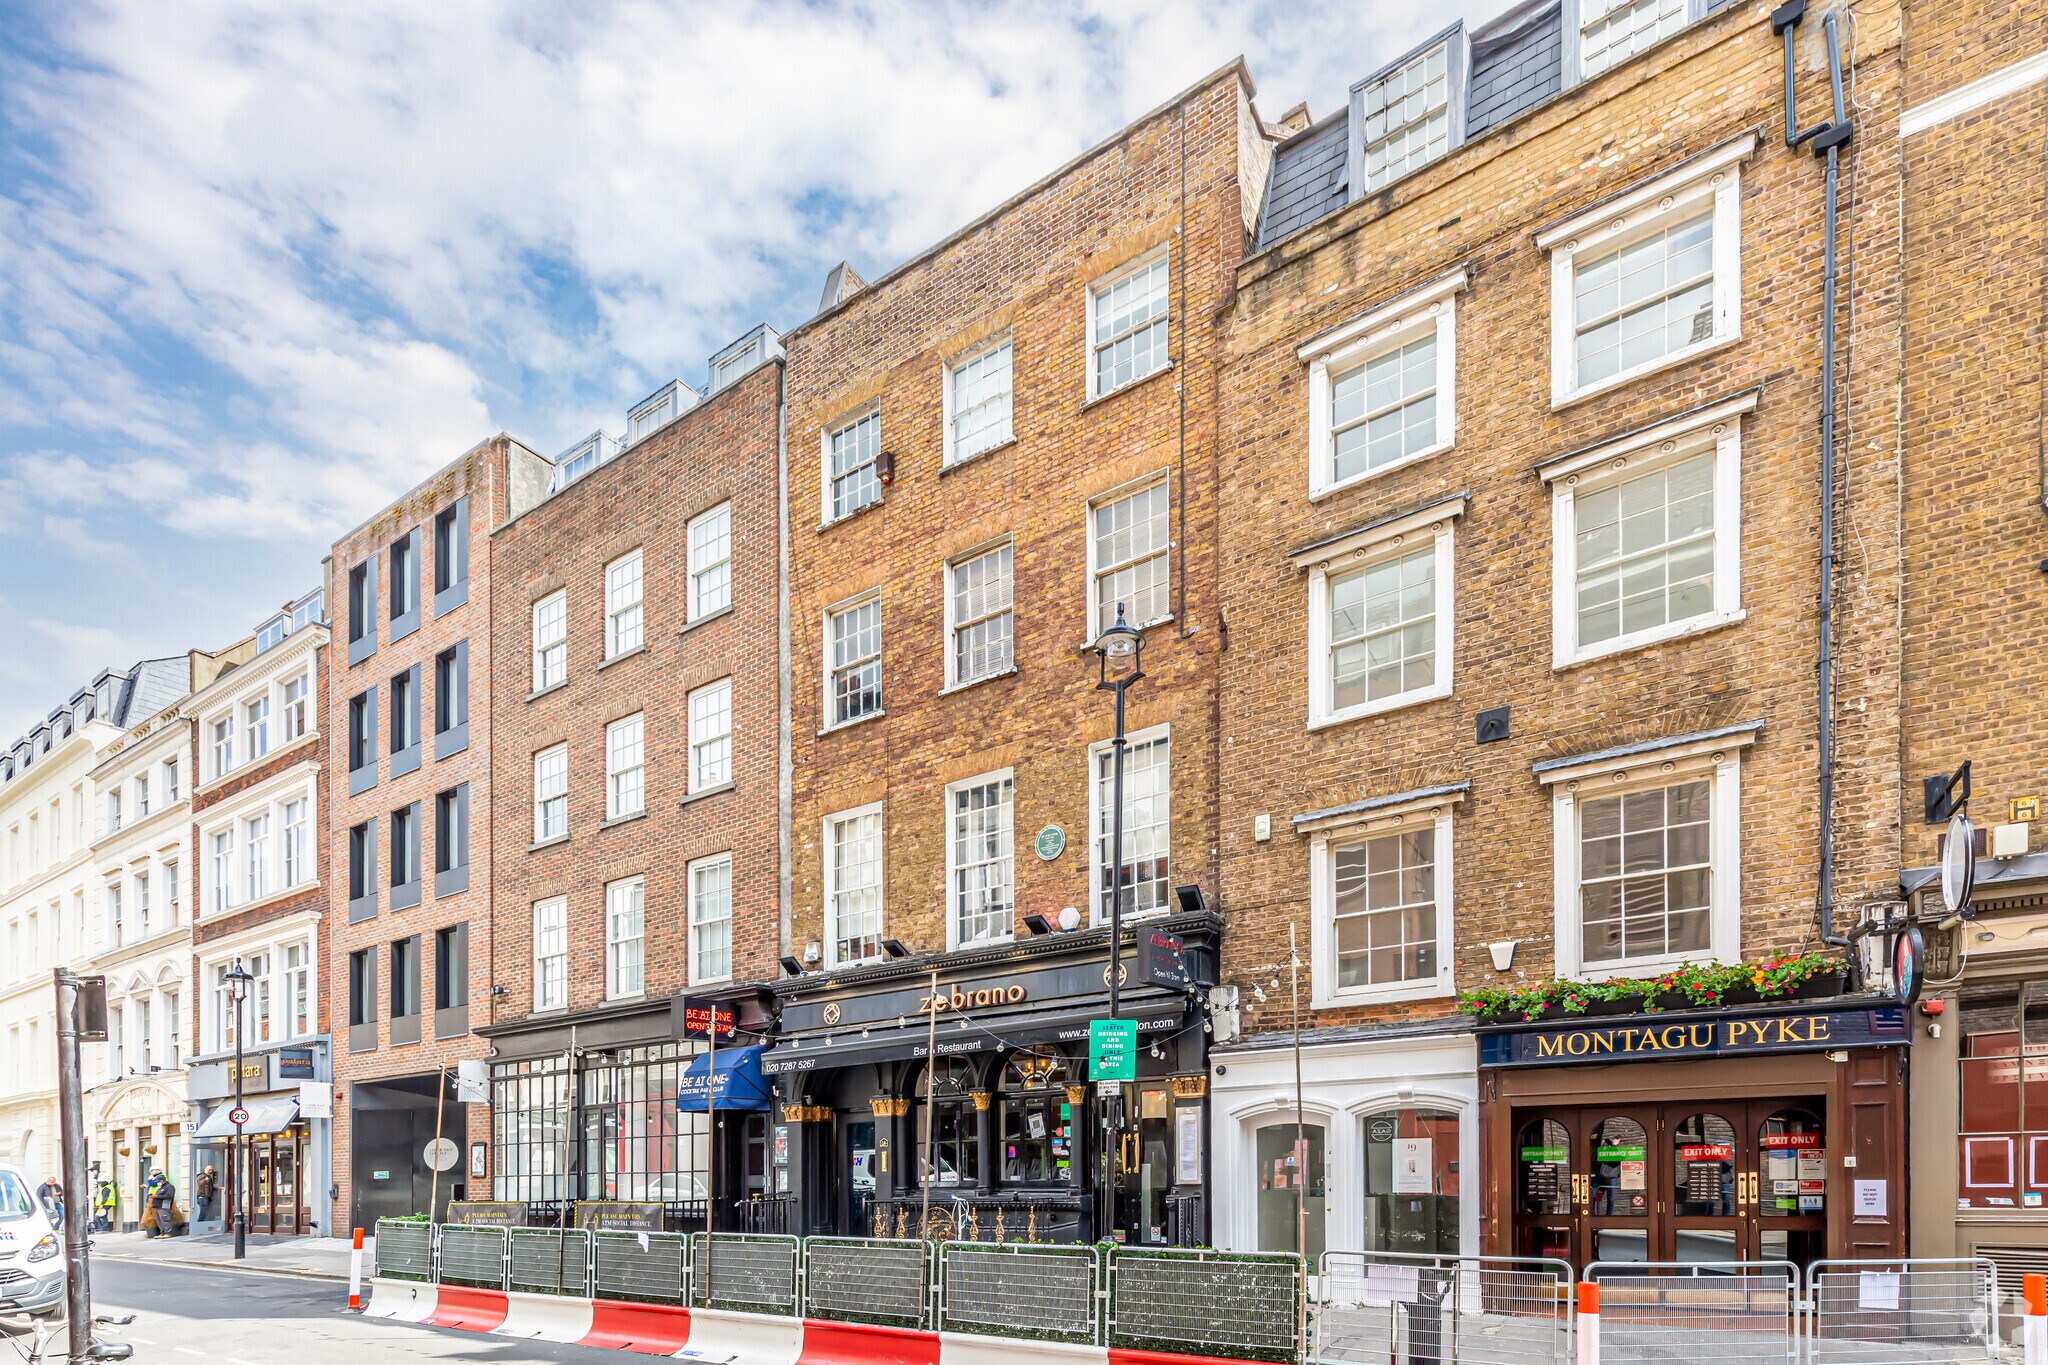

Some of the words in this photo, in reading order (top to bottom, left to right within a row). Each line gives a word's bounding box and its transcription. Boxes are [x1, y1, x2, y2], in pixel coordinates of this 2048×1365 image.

[918, 984, 1025, 1013] zebrano
[686, 1008, 698, 1019] BE
[687, 1021, 705, 1031] OPEN
[1537, 1023, 1715, 1058] MONTAGU
[1726, 1015, 1831, 1046] PYKE
[913, 1045, 928, 1056] Bar
[937, 1040, 982, 1053] Restaurant
[281, 1058, 312, 1066] patara
[766, 1063, 779, 1073] 020
[780, 1061, 797, 1071] 7287
[798, 1059, 816, 1069] 5267
[231, 1063, 262, 1083] ptara
[682, 1078, 694, 1088] BE
[234, 1112, 247, 1120] 20
[186, 1123, 195, 1131] 15
[1769, 1137, 1788, 1145] EXIT
[1790, 1135, 1816, 1144] ONLY
[1704, 1148, 1728, 1156] ONLY
